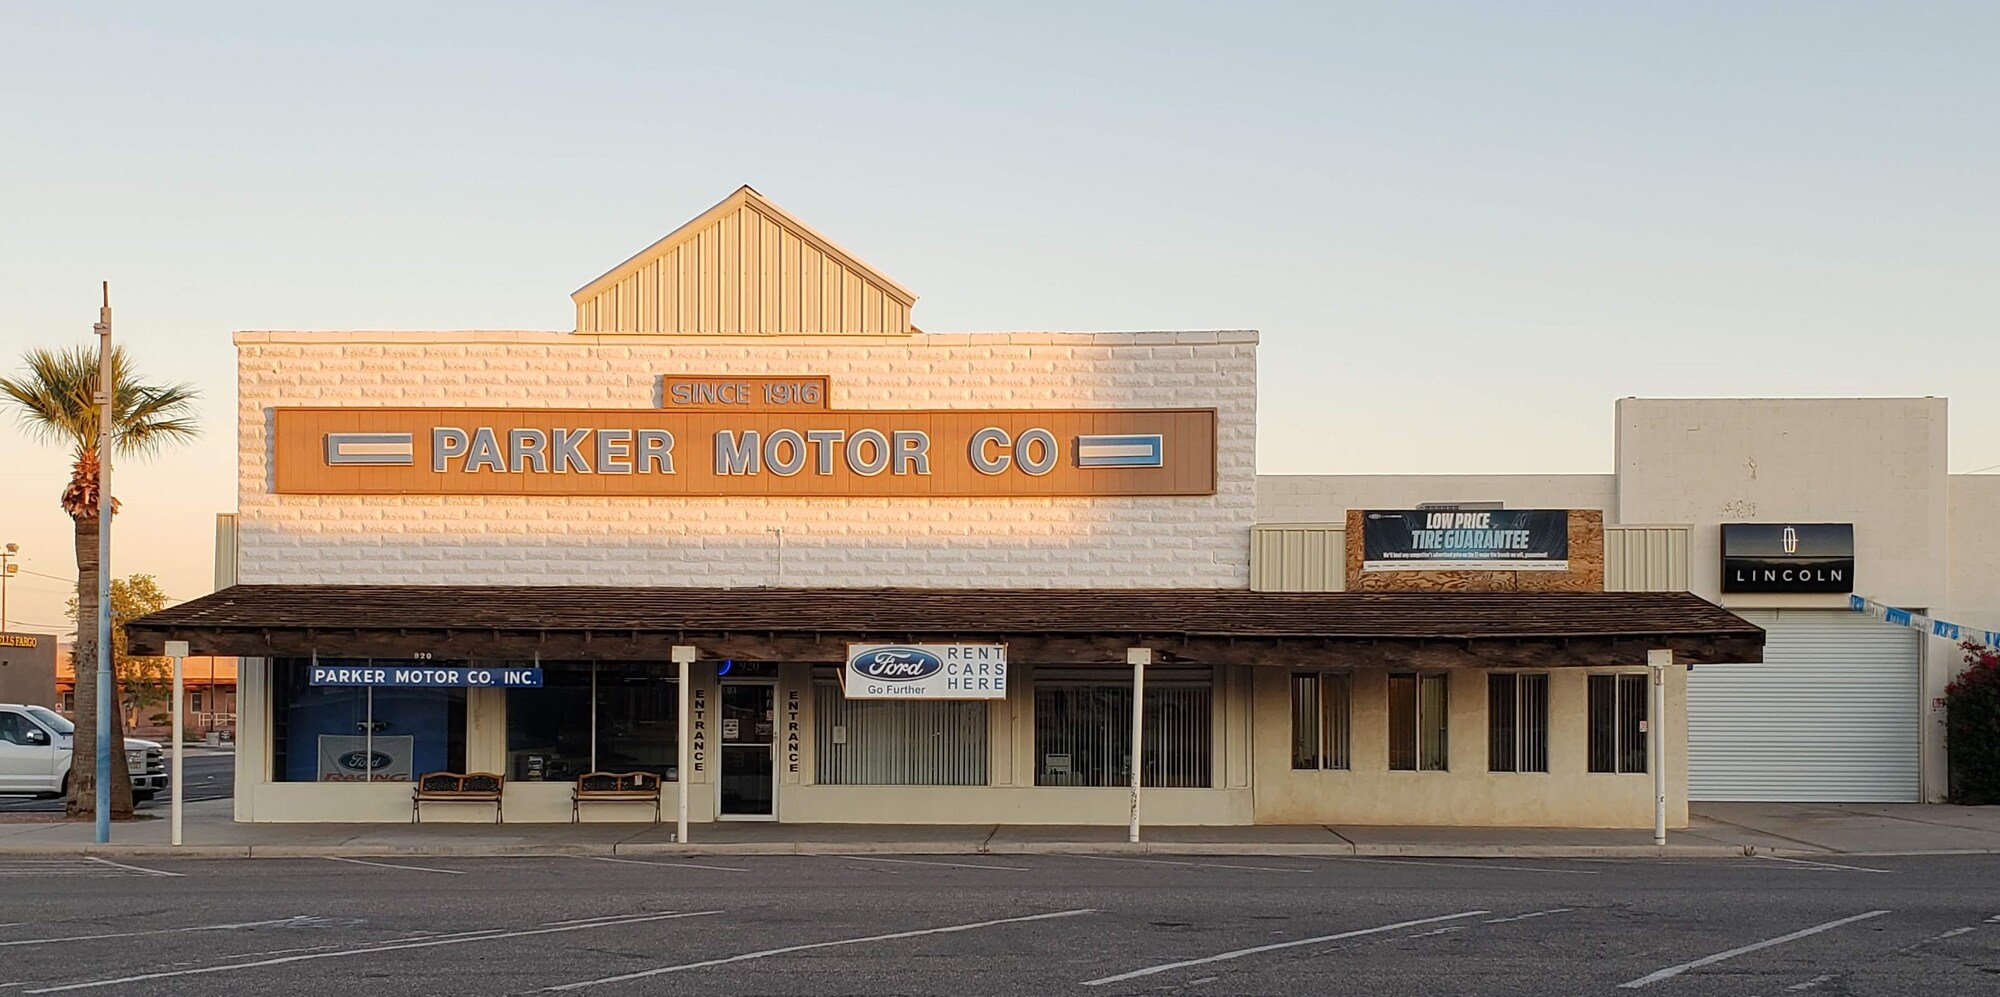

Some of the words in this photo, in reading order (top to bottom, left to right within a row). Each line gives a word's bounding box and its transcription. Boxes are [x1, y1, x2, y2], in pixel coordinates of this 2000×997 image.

[672, 382, 750, 404] SINCE
[762, 382, 820, 404] 1916
[432, 427, 677, 474] PARKER
[714, 428, 932, 477] MOTOR
[969, 427, 1059, 476] CO
[1426, 512, 1454, 529] LOW
[1455, 512, 1490, 529] PRICE
[1411, 530, 1444, 549] TIRE
[1444, 530, 1530, 549] GUARANTEE
[1737, 569, 1843, 582] LINCOLN
[15, 636, 37, 648] FARGO
[414, 652, 432, 660] 920
[948, 647, 1003, 659] RENT
[740, 661, 760, 671] 920
[869, 652, 925, 676] Ford
[947, 663, 1004, 676] CARS
[315, 670, 386, 683] PARKER
[395, 670, 459, 684] MOTOR
[467, 671, 495, 684] CO.
[504, 671, 537, 685] INC.
[948, 678, 1004, 690] HERE
[868, 685, 883, 694] Go
[886, 685, 926, 695] Further
[694, 689, 705, 771] ENTRANCE
[788, 691, 799, 773] ENTRANCE
[349, 753, 382, 767] Fod
